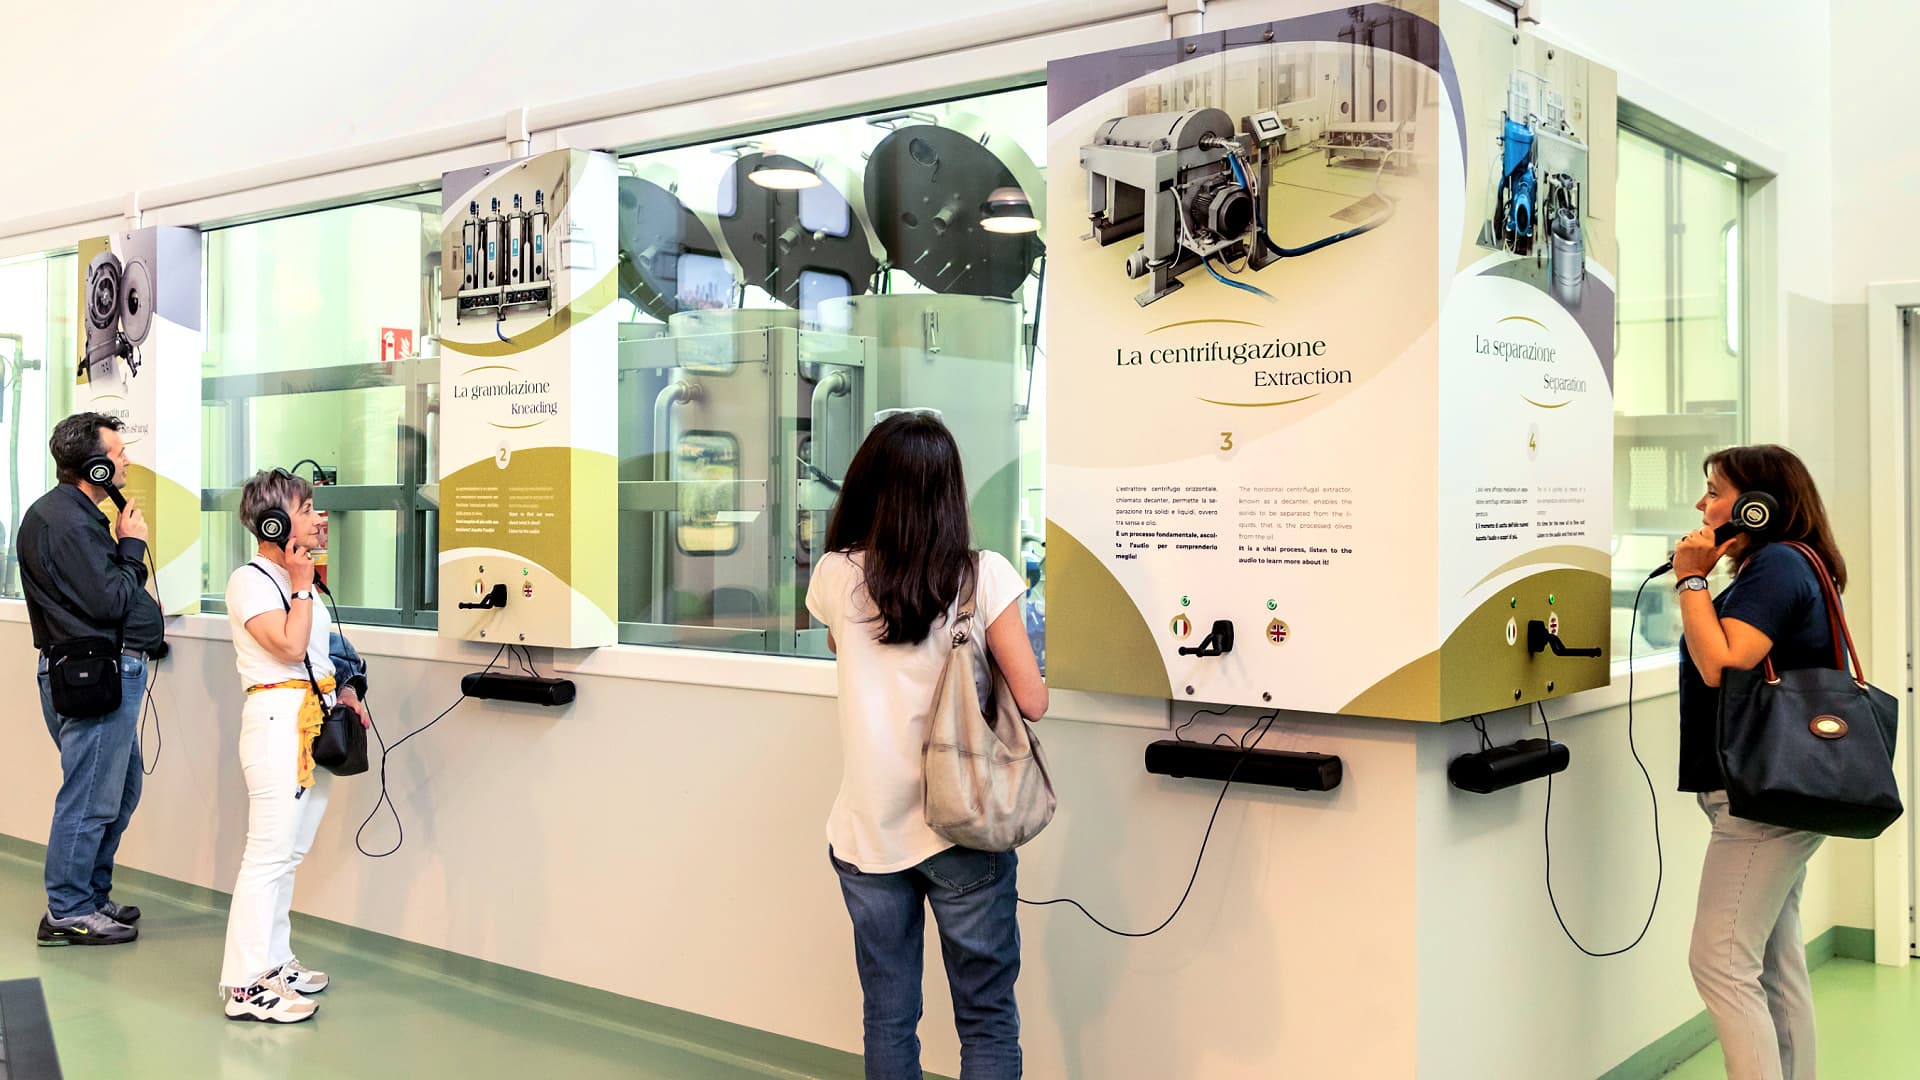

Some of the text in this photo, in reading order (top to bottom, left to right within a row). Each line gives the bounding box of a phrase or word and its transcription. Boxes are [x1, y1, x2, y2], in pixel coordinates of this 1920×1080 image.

[1116, 338, 1327, 366] La centrifugazione
[1476, 334, 1556, 363] La separazione
[1254, 367, 1352, 387] Extraction
[1543, 373, 1587, 393] Separation
[454, 380, 550, 400] La gramolazione
[511, 401, 558, 416] Kneading
[1219, 431, 1233, 451] 3
[1529, 432, 1536, 451] 4
[499, 447, 507, 462] 2
